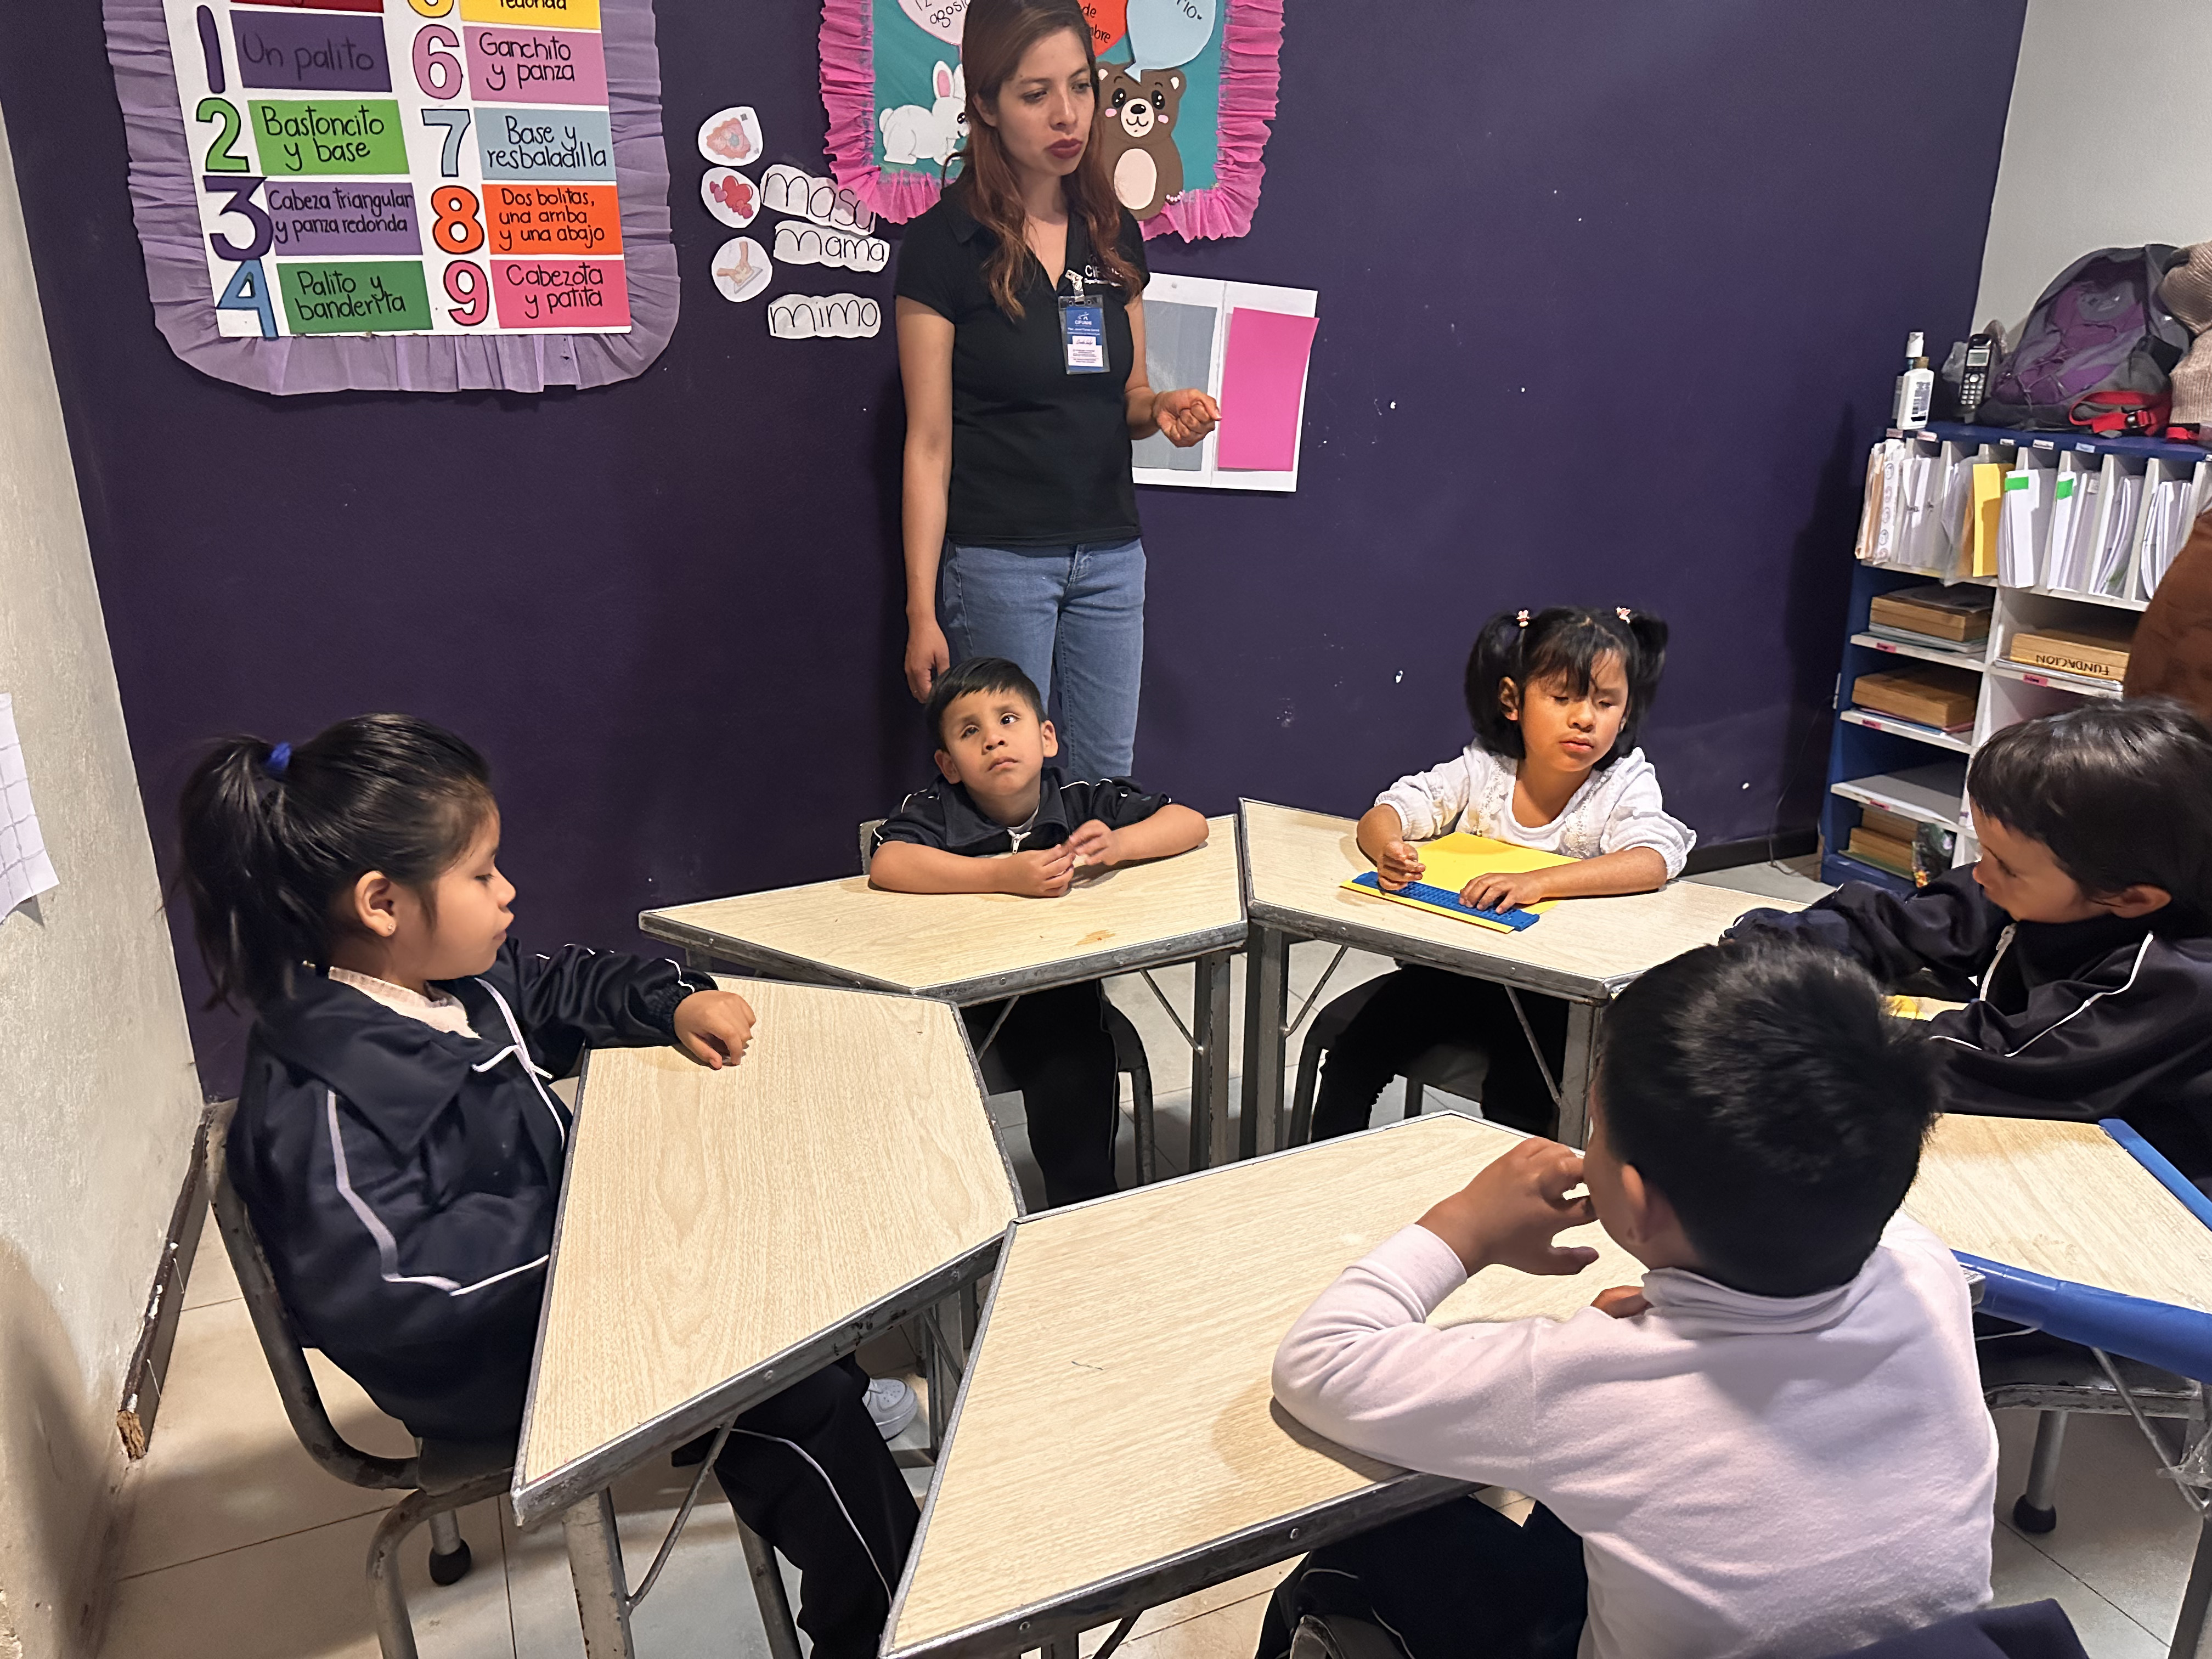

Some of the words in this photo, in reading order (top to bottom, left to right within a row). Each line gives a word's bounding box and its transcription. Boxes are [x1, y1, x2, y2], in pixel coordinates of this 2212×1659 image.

[242, 32, 283, 67] Un
[296, 37, 374, 81] palito
[412, 24, 463, 100] 6
[479, 32, 571, 61] Ganchito
[486, 64, 505, 91] y
[517, 64, 574, 89] panza
[196, 97, 250, 173] 2
[261, 105, 385, 138] Bastoncito
[505, 115, 555, 145] Base
[561, 125, 577, 153] y
[284, 144, 302, 171] y
[313, 137, 370, 162] base
[421, 108, 471, 177] 7
[487, 142, 606, 170] resbaladilla
[268, 189, 330, 211] Cabeza
[335, 187, 413, 217] triangular
[501, 188, 532, 206] Dos
[537, 188, 595, 206] bolitas,
[202, 175, 274, 261] 3
[274, 219, 289, 244] y
[292, 218, 339, 242] panza
[342, 214, 408, 234] redonda
[431, 185, 485, 255] 8
[499, 211, 531, 224] una
[538, 206, 587, 223] arriba
[499, 229, 512, 251] y
[520, 229, 551, 242] una
[556, 225, 605, 249] abajo
[297, 270, 357, 296] Palito
[370, 275, 385, 301] y
[505, 262, 604, 286] Cabezota
[215, 258, 280, 341] 4
[296, 291, 406, 321] banderita
[443, 260, 490, 326] 9
[524, 292, 539, 319] y
[547, 286, 603, 314] patita
[770, 300, 878, 334] mimo
[2036, 654, 2110, 676] FUNDACION
